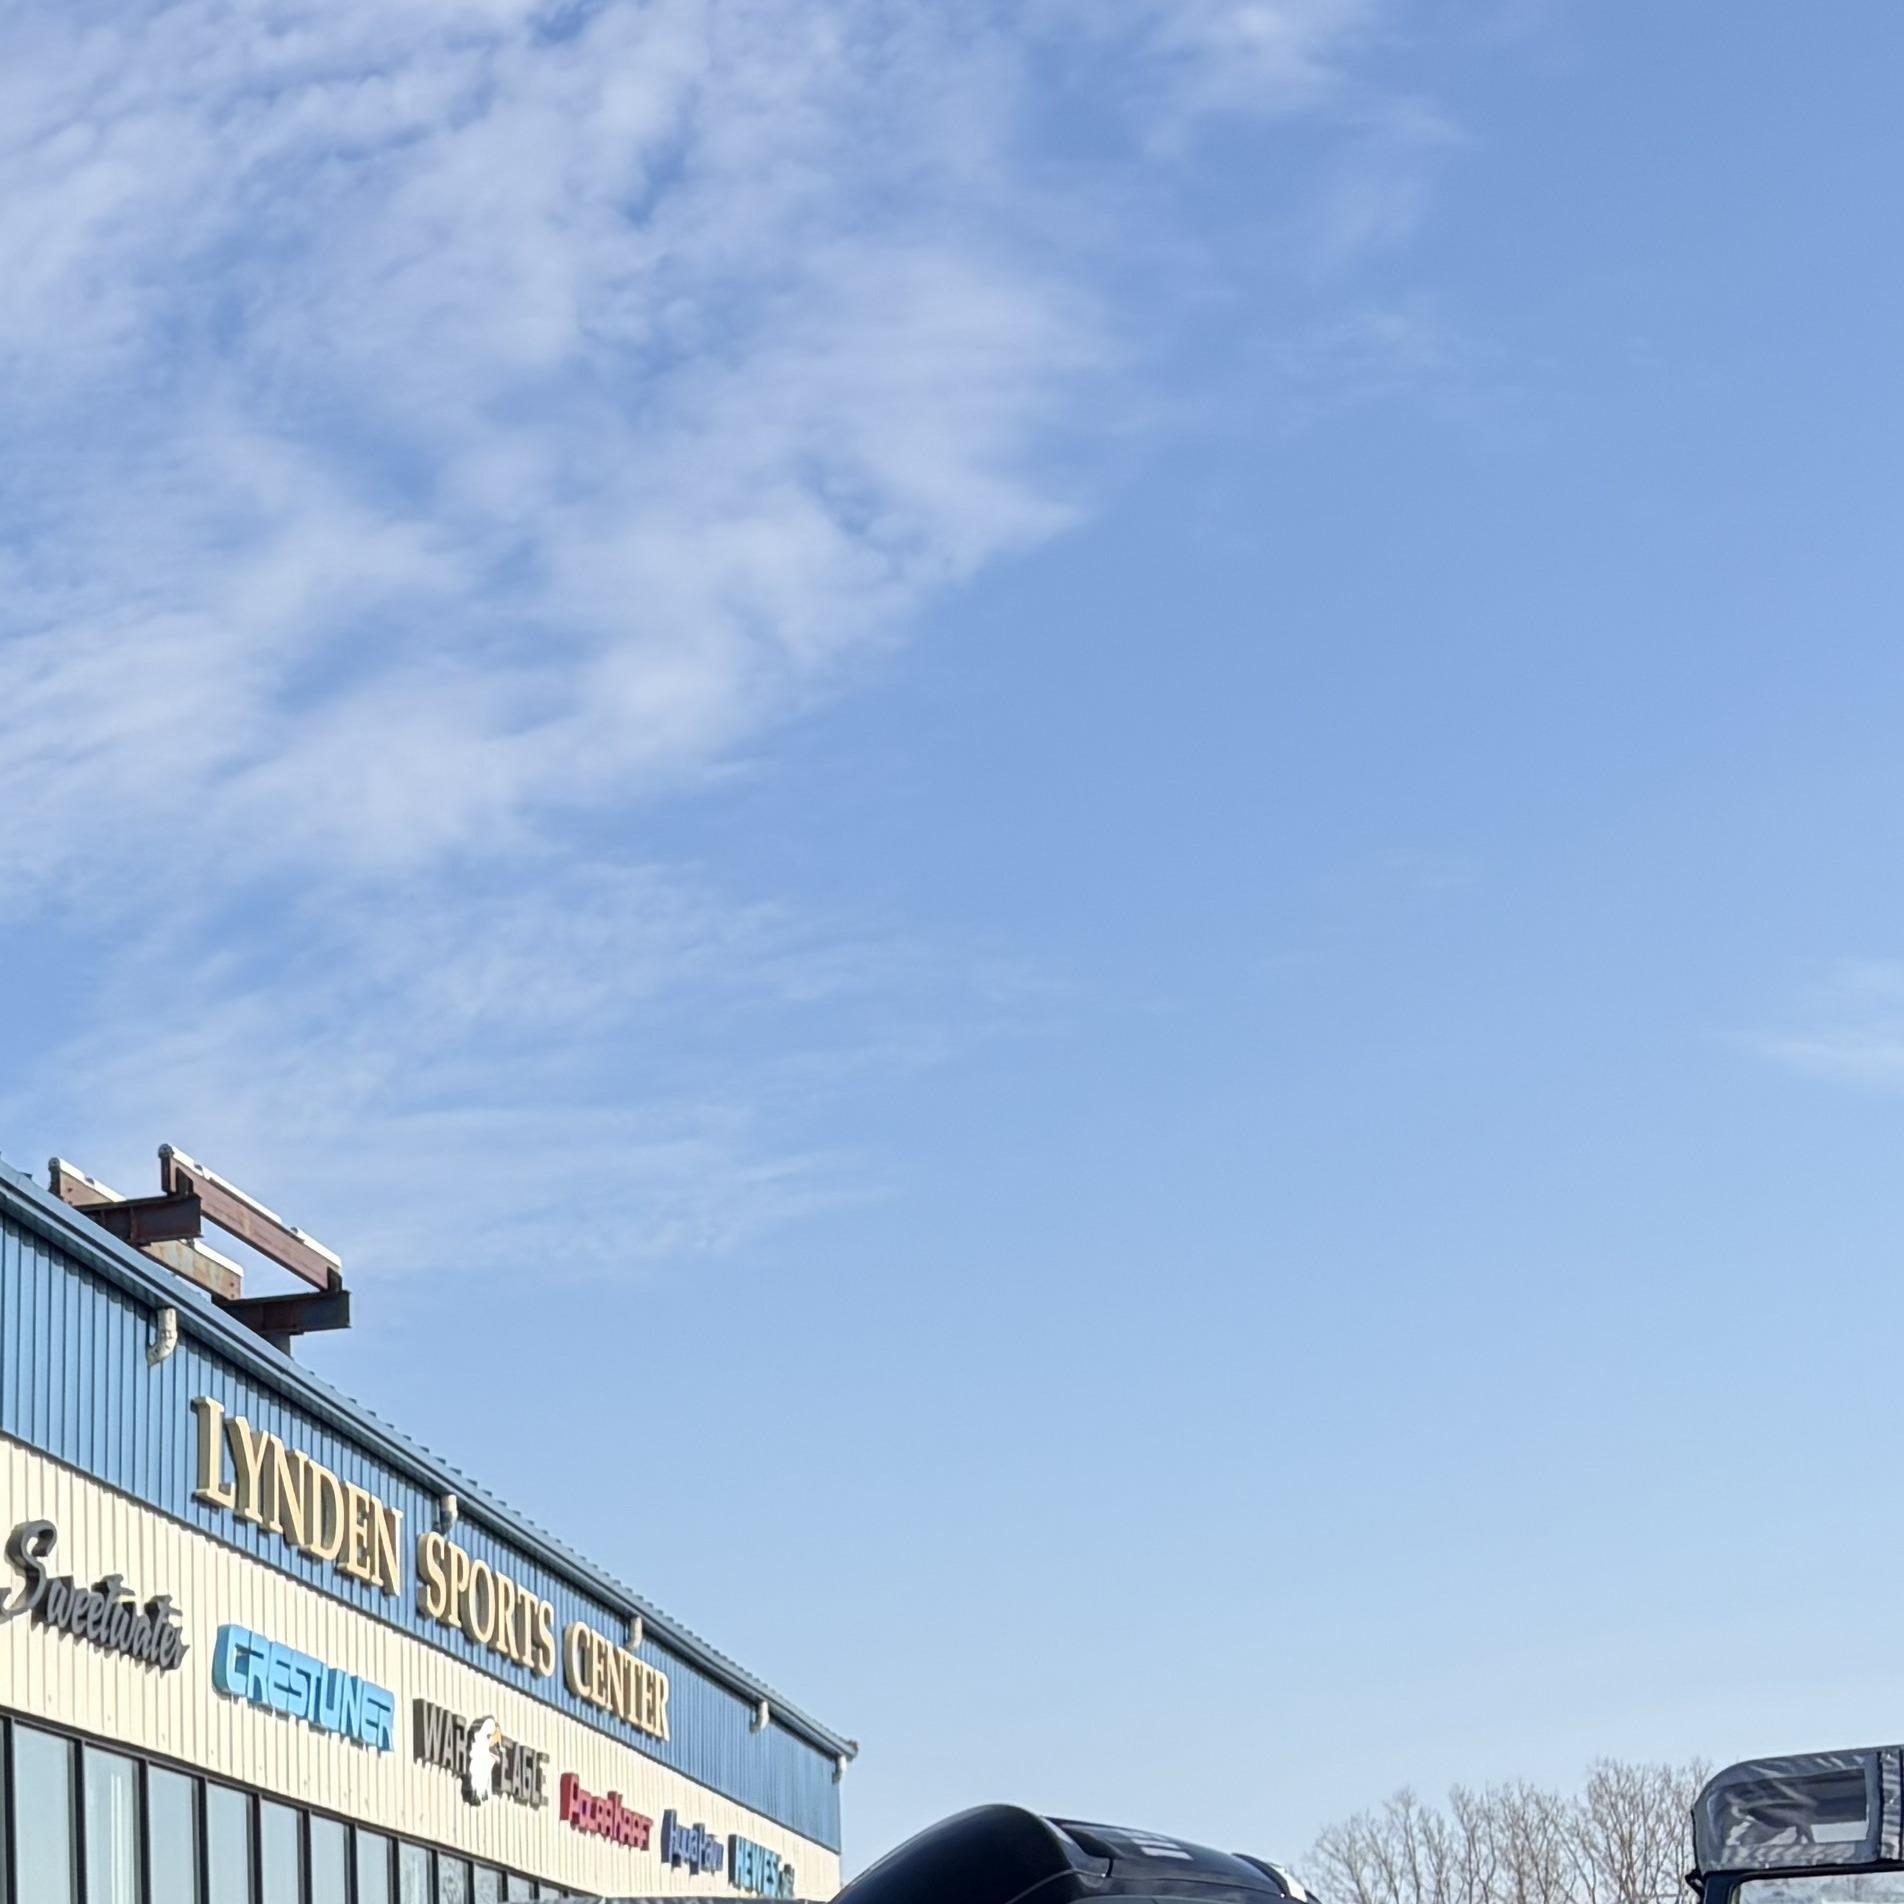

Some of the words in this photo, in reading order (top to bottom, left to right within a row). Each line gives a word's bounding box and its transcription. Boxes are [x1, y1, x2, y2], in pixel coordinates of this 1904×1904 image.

[191, 1396, 404, 1597] LYNDEN
[418, 1531, 555, 1677] SPORTS
[564, 1621, 670, 1741] CENTER
[212, 1624, 394, 1752] CRESTLINER
[413, 1698, 468, 1778] WAR
